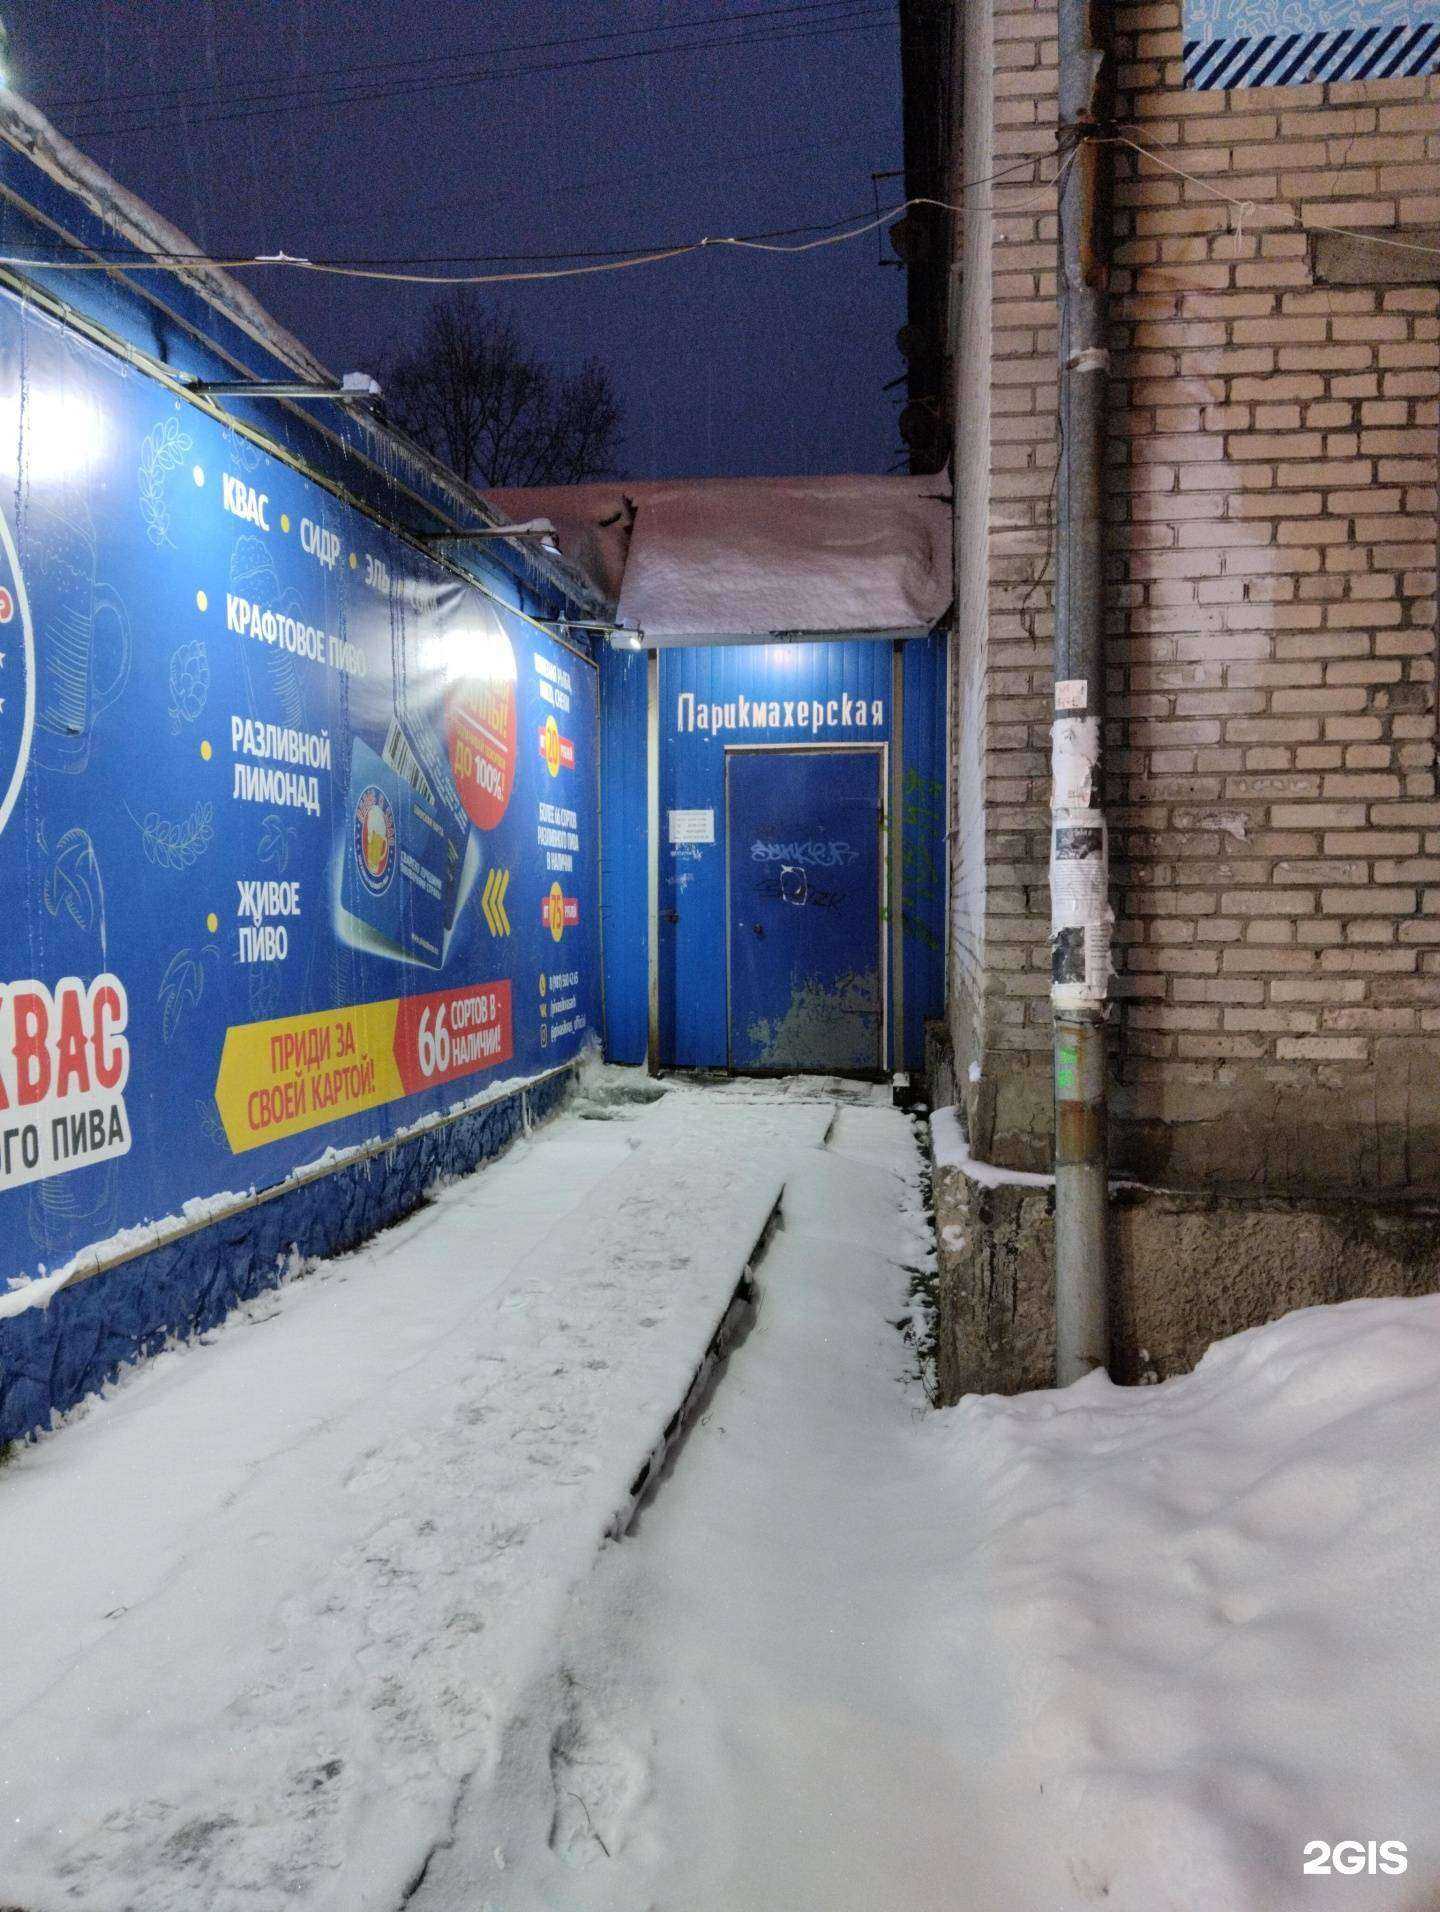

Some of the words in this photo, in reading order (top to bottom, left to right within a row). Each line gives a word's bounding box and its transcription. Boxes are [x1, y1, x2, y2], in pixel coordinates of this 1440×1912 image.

[222, 472, 270, 531] КВАС
[300, 518, 341, 570] СИДР
[226, 593, 326, 662] КРАФТОВОЕ
[329, 635, 368, 678] ПИВО
[677, 692, 883, 736] Парикмахерская
[231, 715, 331, 770] РАЗЛИВНОЙ
[233, 763, 320, 816] ЛИМОНАД
[237, 881, 301, 918] ЖИВОЕ
[239, 926, 288, 963] ПИВО
[0, 986, 123, 1110] ВАС
[270, 1031, 331, 1074] ПРИДИ
[335, 1022, 356, 1056] ЗА
[418, 1003, 449, 1077] 66
[451, 997, 487, 1029] СОРТОВ
[489, 994, 496, 1021] В
[452, 1027, 501, 1066] НАЛИЧИИ!
[247, 1068, 307, 1131] СВОЕЙ
[311, 1053, 375, 1112] КАРТОЙ!
[0, 1124, 39, 1175] ГО
[52, 1104, 124, 1162] ПИВА
